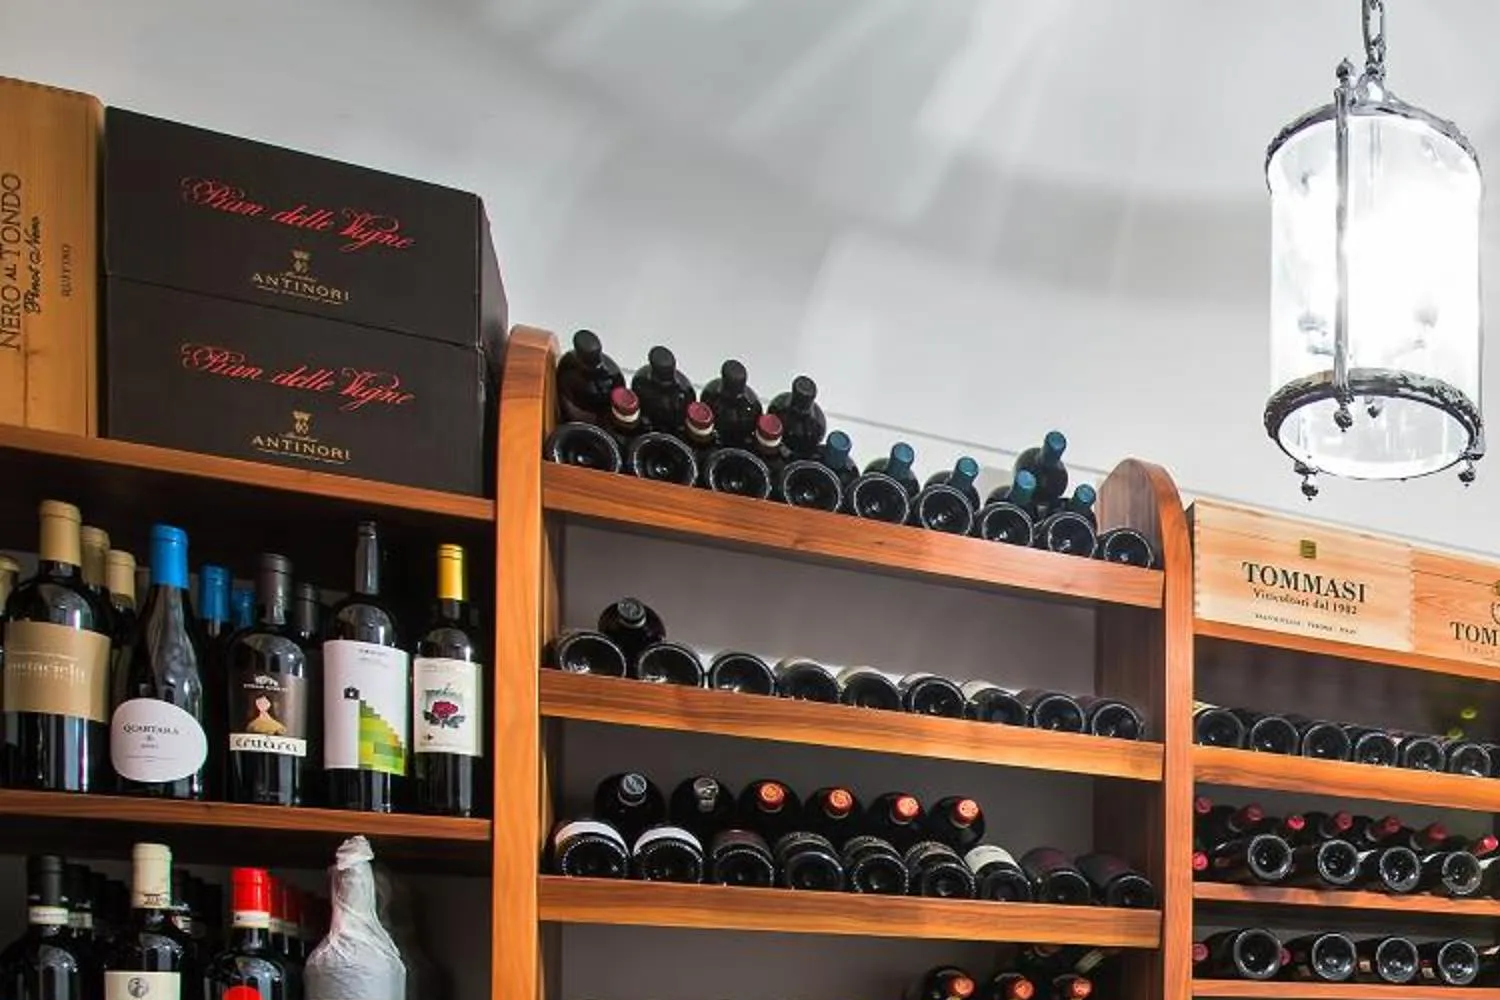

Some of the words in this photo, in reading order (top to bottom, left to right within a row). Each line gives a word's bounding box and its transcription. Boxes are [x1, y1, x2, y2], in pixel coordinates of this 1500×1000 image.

[0, 173, 21, 257] TONDO
[180, 177, 265, 217] Pian
[270, 205, 335, 231] delle
[339, 207, 416, 253] Vigne
[5, 264, 17, 280] AL
[24, 264, 41, 315] Pinot
[252, 272, 350, 301] ANTINORI
[0, 285, 21, 352] NERO
[180, 343, 264, 381] Pian
[270, 365, 335, 391] delle
[339, 367, 416, 412] Vigne
[252, 435, 351, 461] ANTINORI
[1241, 561, 1366, 603] TOMMASI
[1313, 598, 1329, 611] dal
